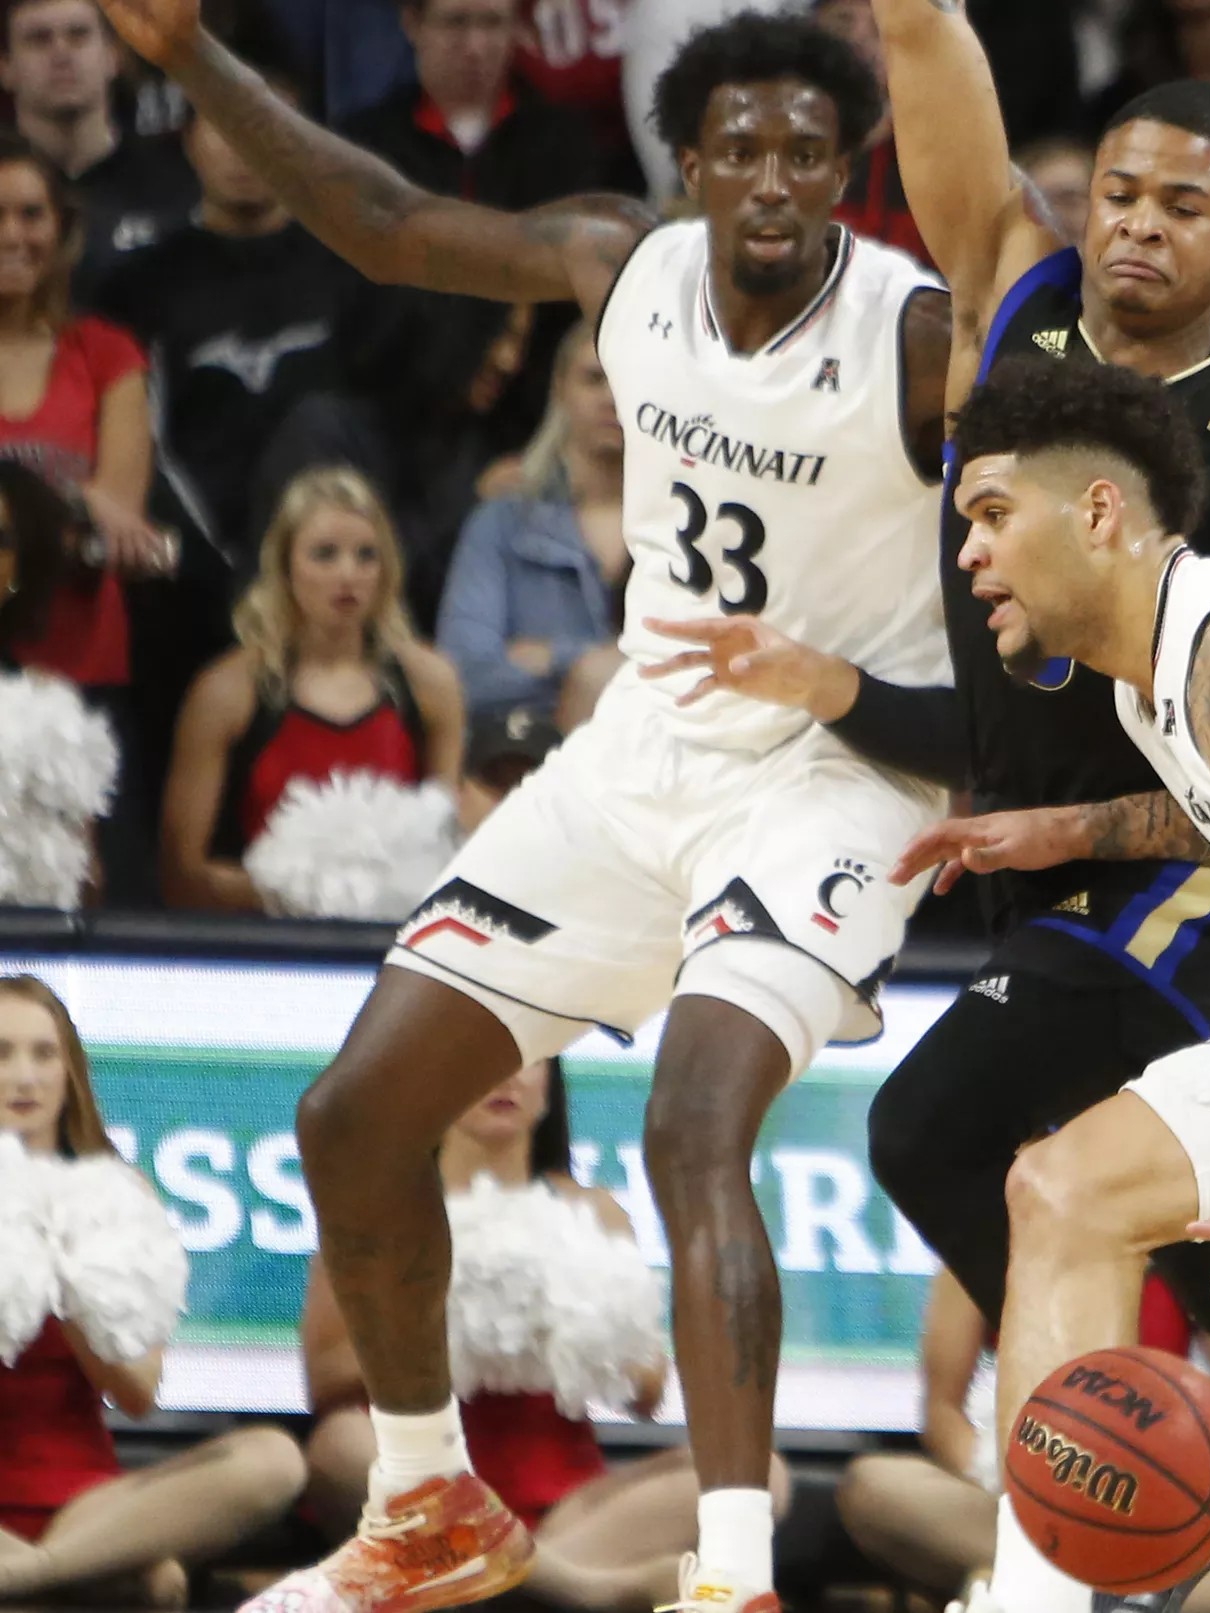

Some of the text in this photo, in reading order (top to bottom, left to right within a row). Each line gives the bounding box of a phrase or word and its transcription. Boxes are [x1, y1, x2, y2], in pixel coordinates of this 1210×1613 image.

[636, 402, 827, 486] CINCINNATI
[669, 481, 768, 618] 33
[1017, 1413, 1140, 1517] Wilson
